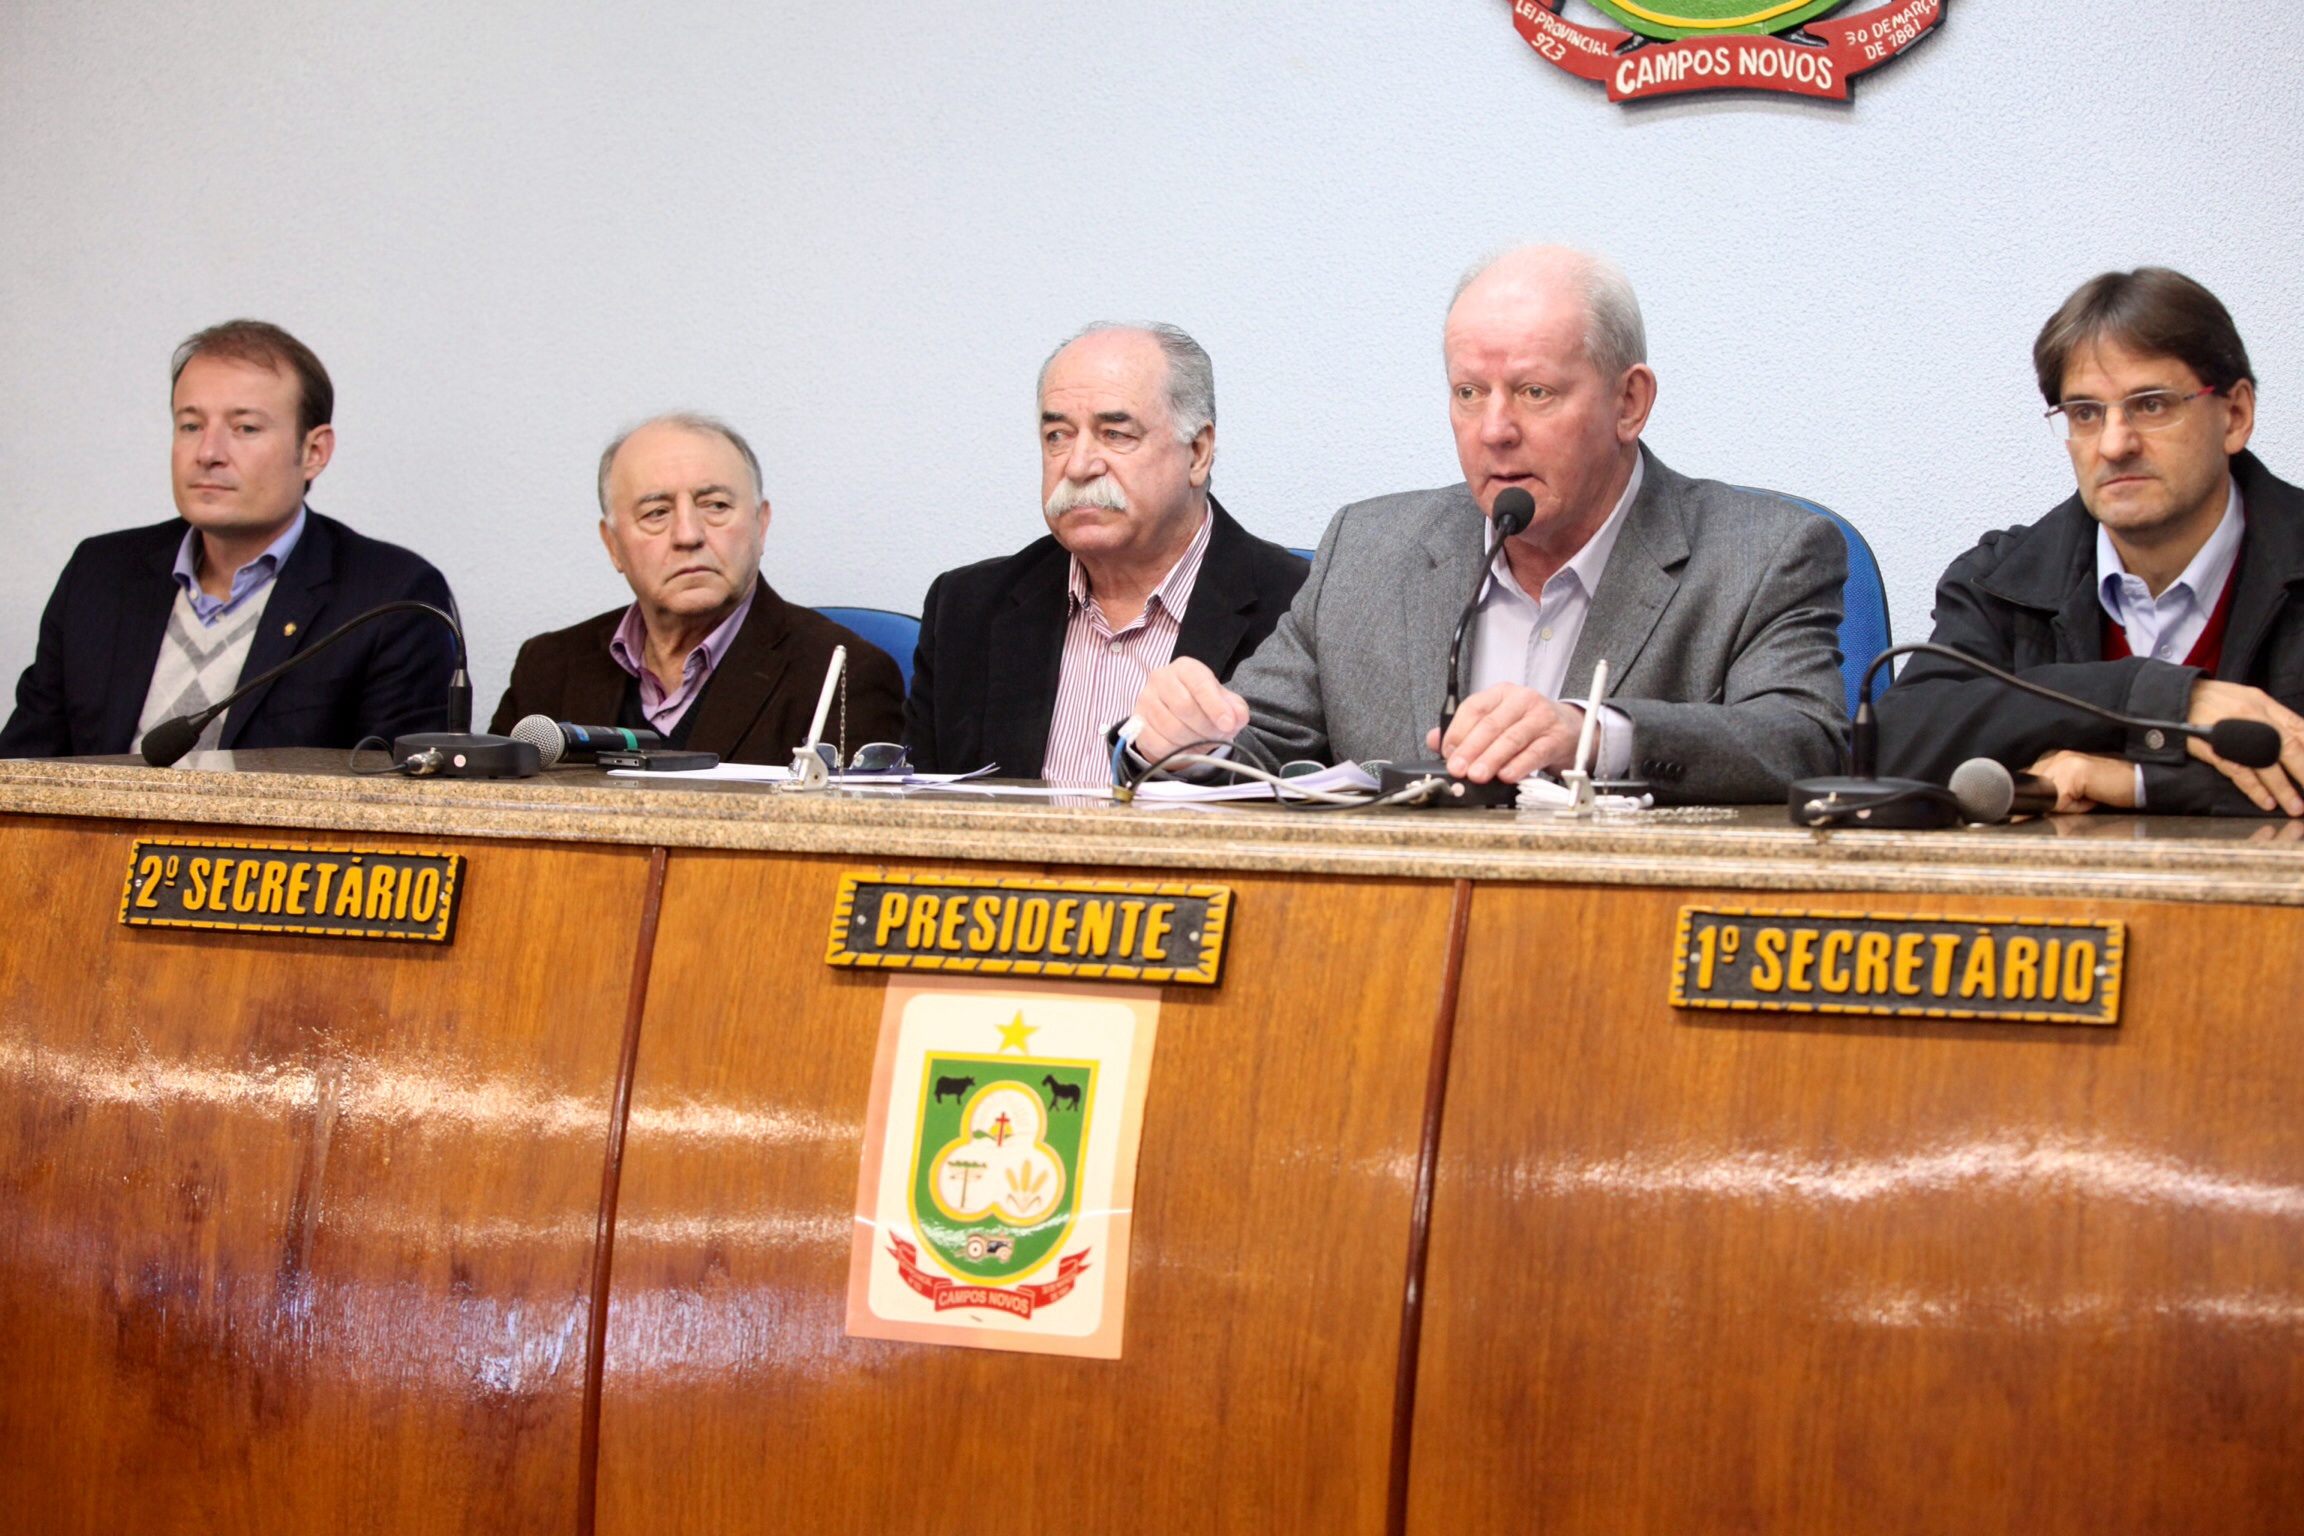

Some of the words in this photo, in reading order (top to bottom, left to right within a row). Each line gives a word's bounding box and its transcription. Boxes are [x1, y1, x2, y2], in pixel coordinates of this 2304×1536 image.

[1515, 0, 1537, 20] LEI
[1534, 11, 1609, 56] PROVINCIAL
[1531, 32, 1566, 60] 923
[1845, 29, 1868, 46] 30
[1864, 41, 1887, 60] DE
[1888, 18, 1921, 47] 1881
[1615, 48, 1730, 94] CAMPOS
[1738, 47, 1834, 89] NOVOS
[182, 856, 441, 923] SECRETÁRIO
[875, 892, 1176, 960] PRESIDENTE
[1750, 927, 2097, 1004] SECRETÁRIO
[938, 1289, 987, 1306] CAMPOS
[987, 1290, 1029, 1315] NOVOS
